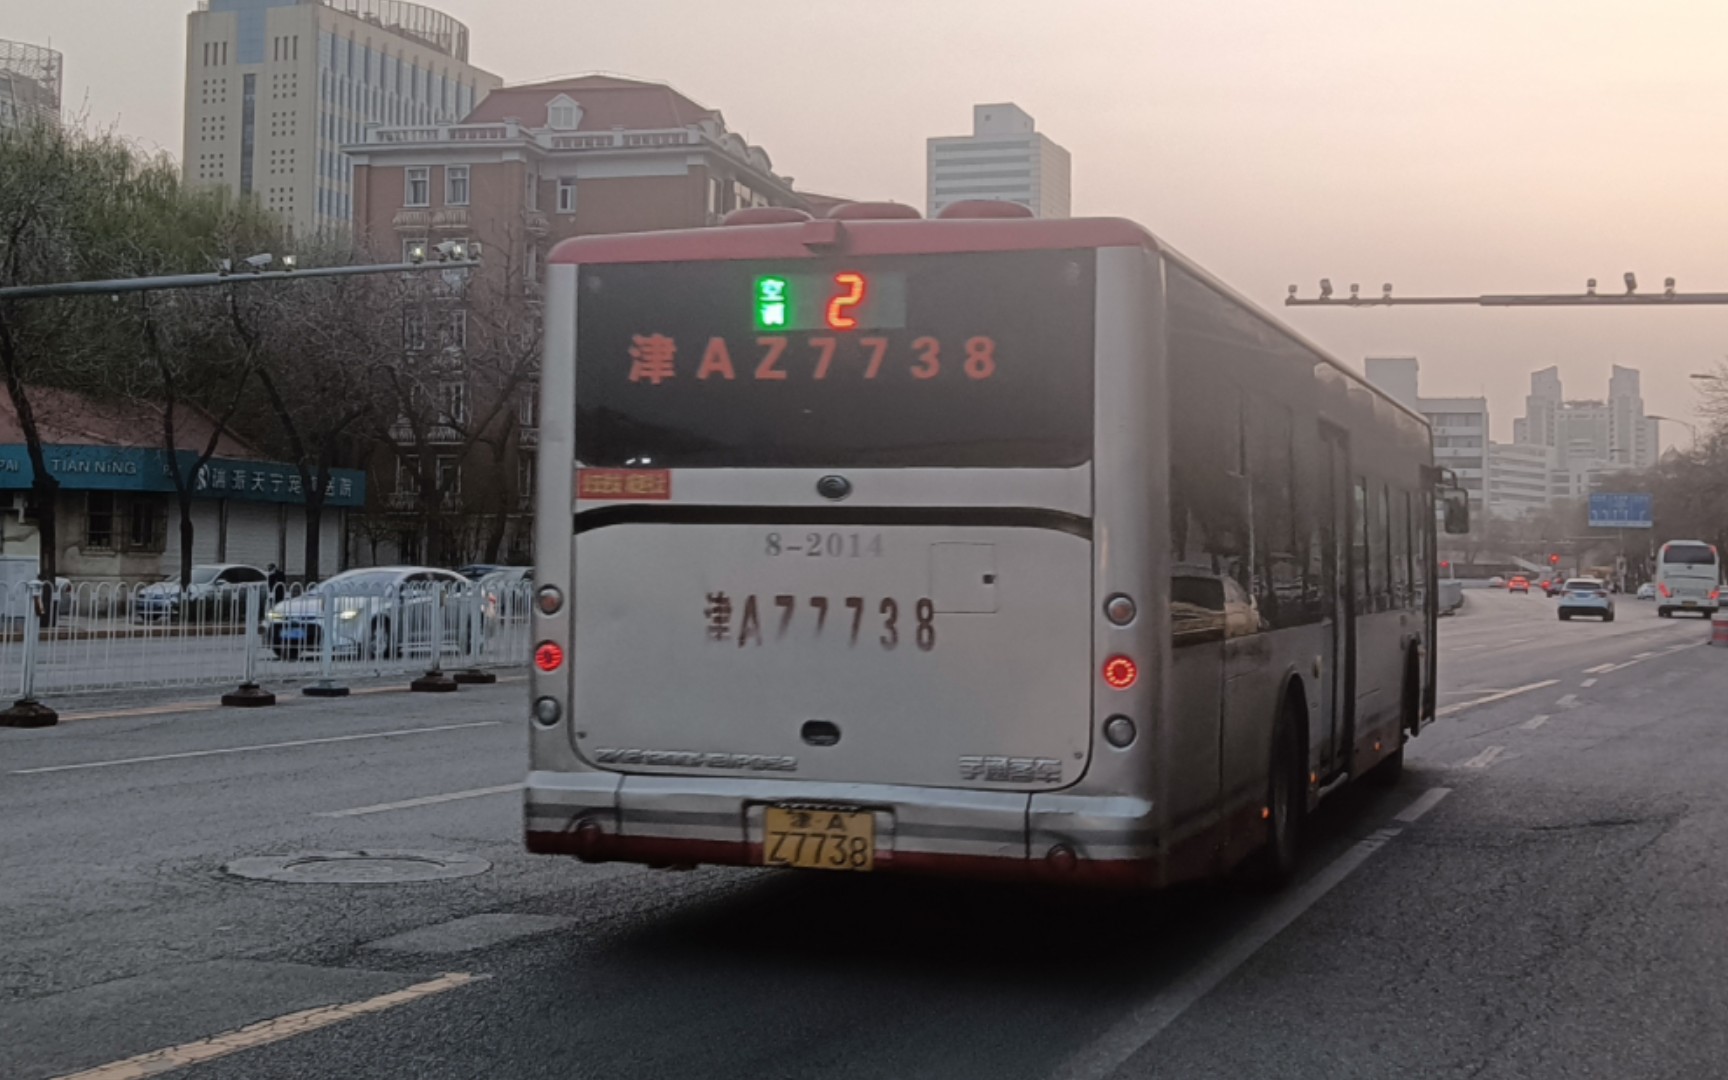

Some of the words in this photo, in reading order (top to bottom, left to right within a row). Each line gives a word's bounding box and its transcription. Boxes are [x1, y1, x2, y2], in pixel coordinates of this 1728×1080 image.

[828, 273, 864, 327] 2
[628, 333, 997, 384] 津AZ7738
[51, 459, 91, 473] TIAN
[212, 468, 353, 498] 瑞派天宁宠医院
[765, 532, 884, 557] 8-2014
[768, 831, 868, 867] Z7738
